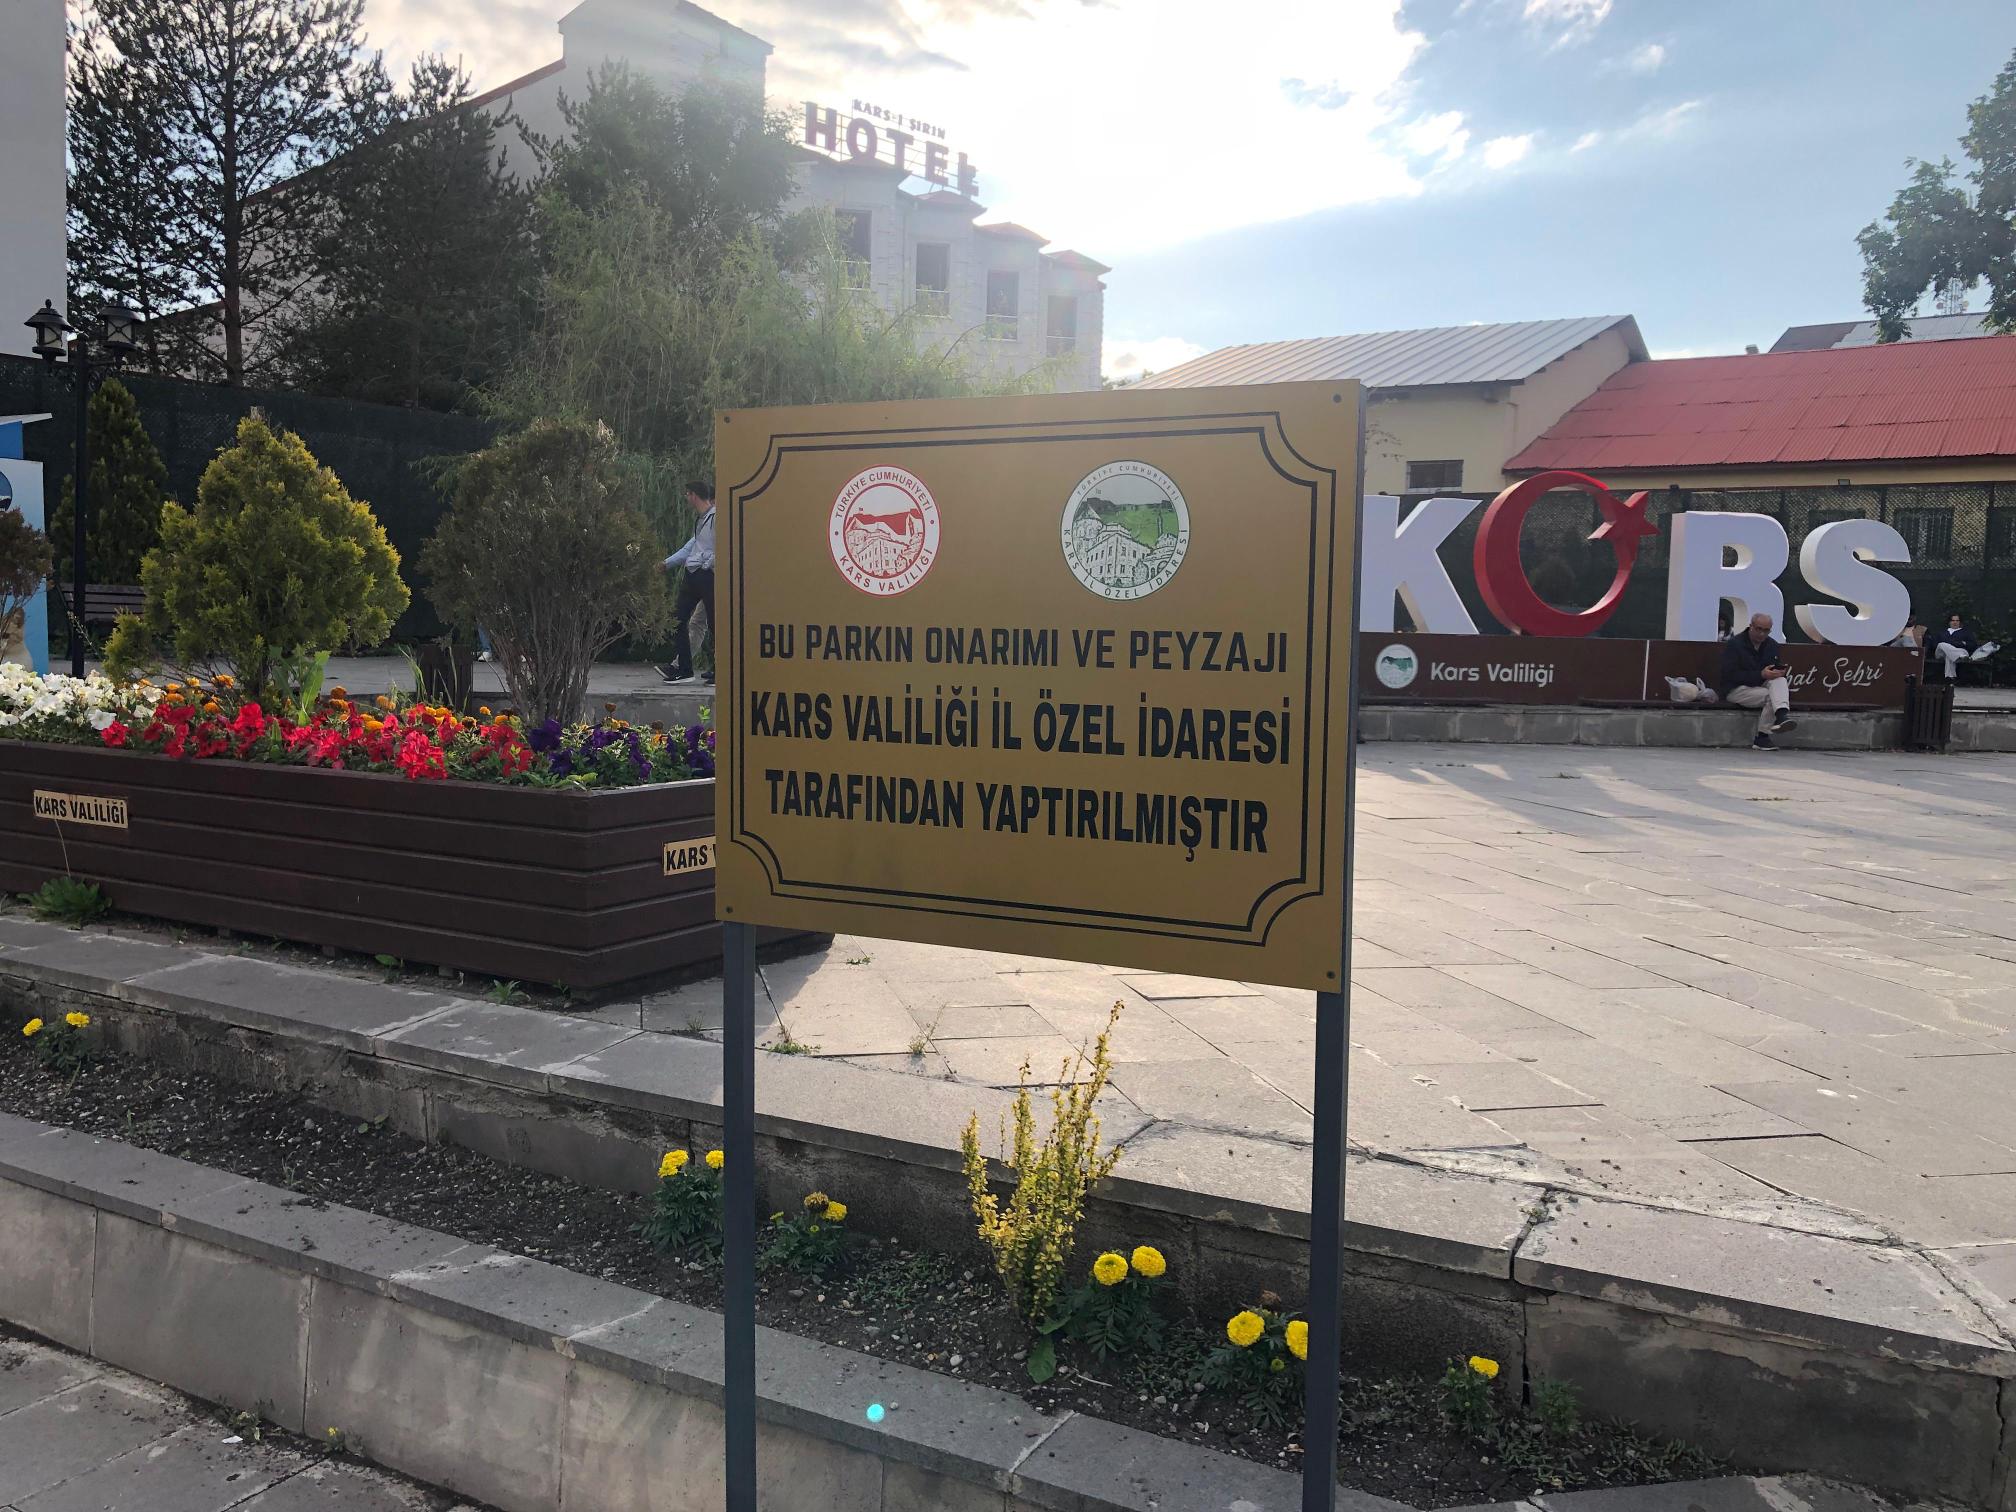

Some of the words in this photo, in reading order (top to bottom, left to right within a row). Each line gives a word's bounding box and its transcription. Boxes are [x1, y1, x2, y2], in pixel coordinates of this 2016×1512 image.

[805, 101, 980, 198] HOTEL
[834, 476, 870, 519] TÜRKİYE
[869, 471, 934, 512] CUMHURİYETİ
[839, 555, 871, 588] KARS
[878, 547, 934, 592] VALİLİĞİ
[1063, 528, 1081, 571] KARS
[759, 623, 795, 660] BU
[805, 624, 913, 663] PARKIN
[925, 627, 1059, 667] ONARIMI
[1072, 629, 1116, 669] VE
[1129, 631, 1288, 673] PEYZAJI
[1431, 661, 1481, 682] Kars
[1487, 661, 1555, 688] Valiliği
[751, 690, 832, 740] KARS
[843, 684, 979, 748] VALİLİĞİ
[992, 687, 1022, 750] İL
[1033, 689, 1125, 756] ÖZEL
[1138, 692, 1291, 765] İDARESİ
[36, 796, 66, 817] KARS
[69, 799, 125, 824] VALİLİĞİ
[765, 769, 965, 829] TARAFINDAN
[975, 783, 1269, 862] YAPTIRILMIŞTIR
[666, 844, 708, 871] KARS
